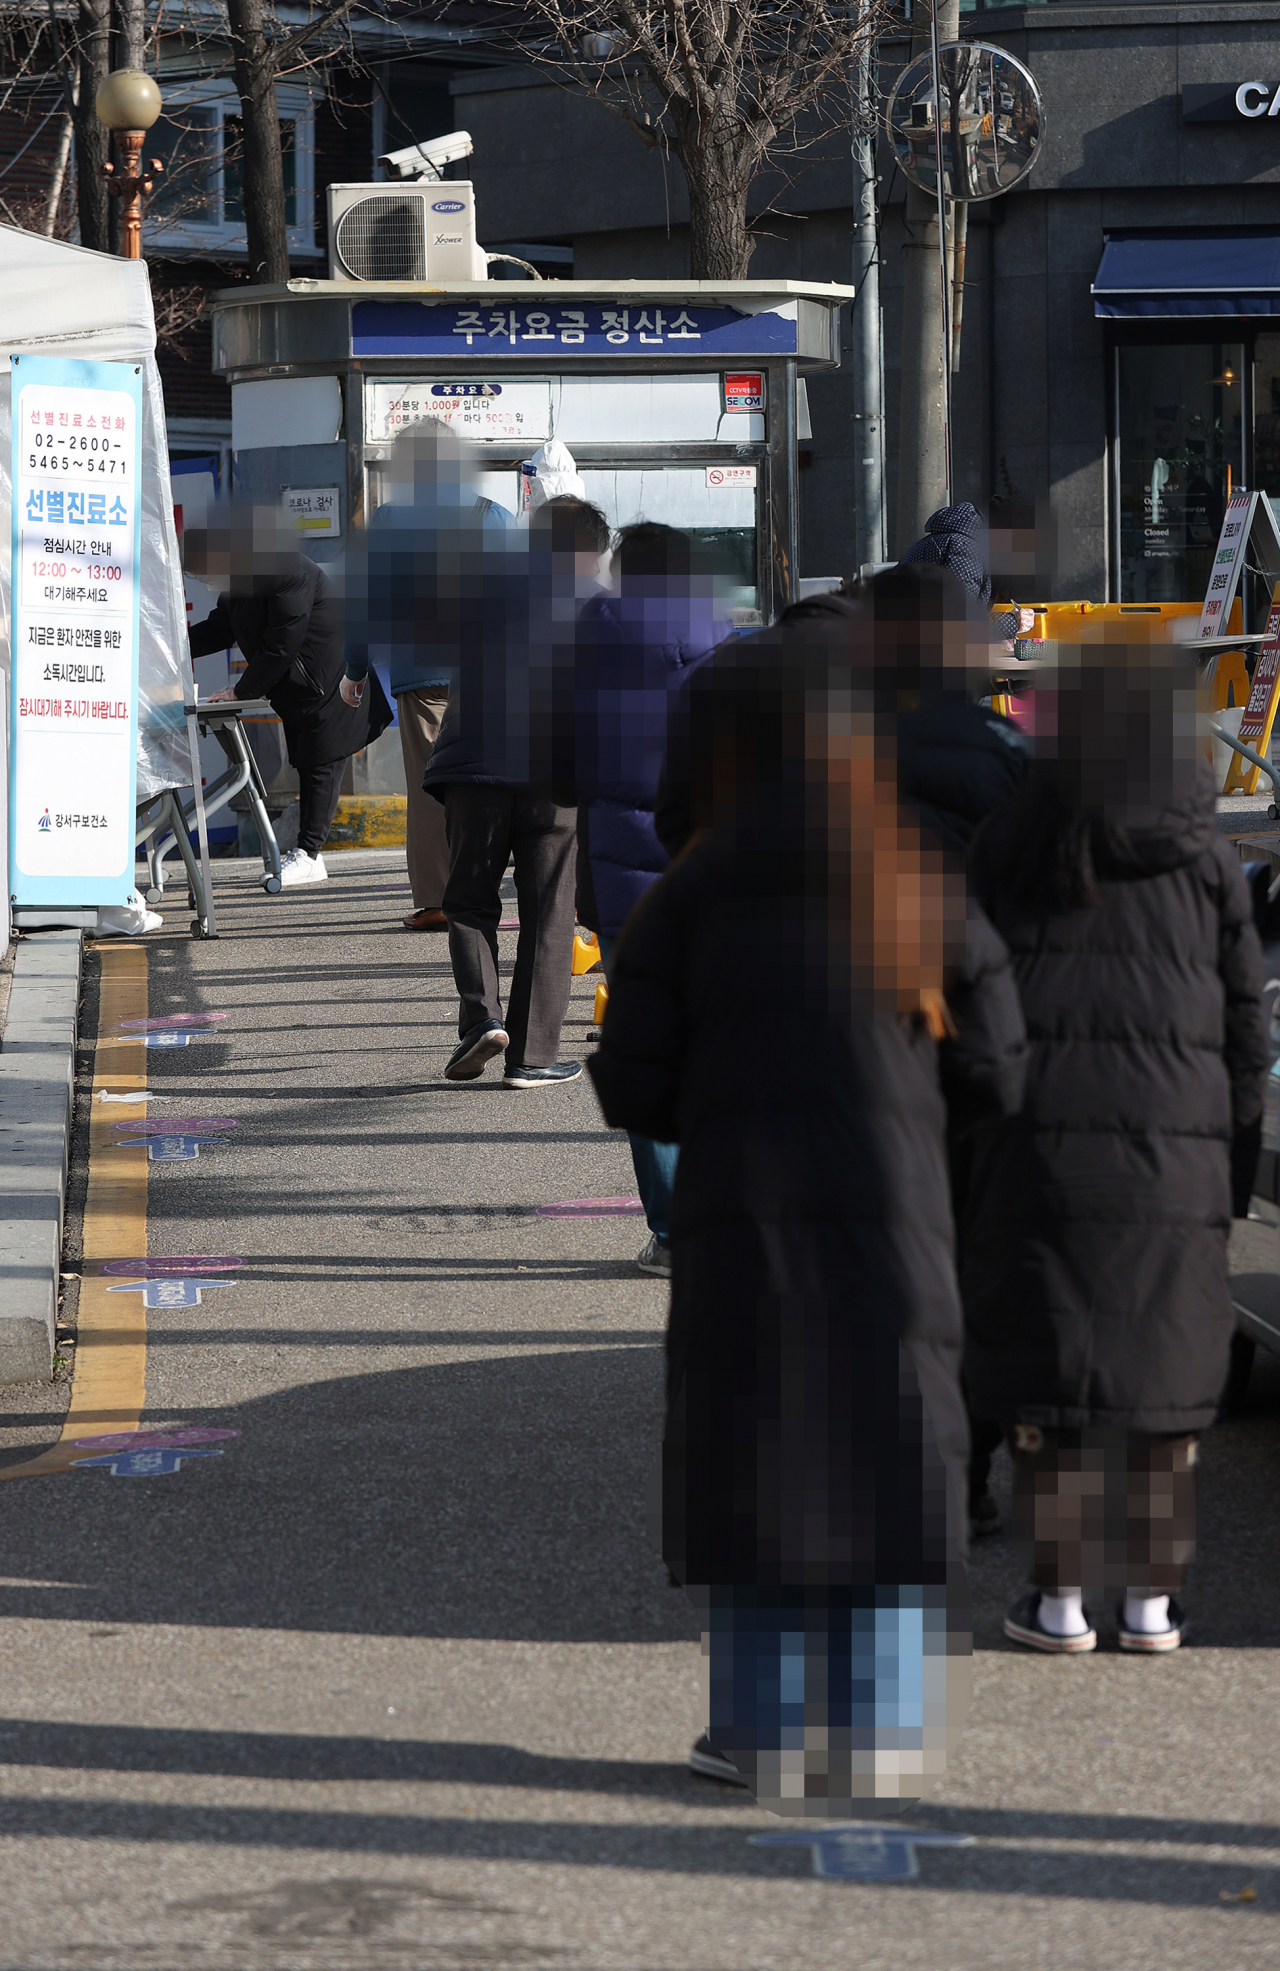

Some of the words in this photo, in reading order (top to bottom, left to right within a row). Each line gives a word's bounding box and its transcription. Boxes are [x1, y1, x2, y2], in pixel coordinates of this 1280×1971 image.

[435, 202, 462, 211] Carrier
[452, 309, 590, 346] 주차요금
[599, 308, 702, 345] 정산소
[389, 400, 420, 411] 30분당
[463, 400, 490, 411] 입니다
[726, 396, 761, 406] SECOM
[30, 409, 126, 432] 선별진료소전화
[464, 413, 482, 424] 마다
[35, 433, 122, 452] 02-2600-
[29, 454, 127, 475] 5465~5471
[26, 489, 128, 526] 선별진료소
[289, 497, 311, 508] 코로나
[316, 495, 333, 507] 검사
[43, 537, 87, 556] 점심시간
[90, 539, 112, 557] 안내
[32, 562, 67, 578] 12:00
[87, 565, 122, 581] 13:00
[44, 586, 108, 603] 대기해주세요
[28, 626, 55, 647] 지금은
[57, 627, 74, 648] 환자
[75, 628, 102, 649] 안전을
[103, 630, 122, 649] 위한
[43, 663, 106, 684] 소독시간입니다.
[1247, 683, 1272, 713] 출입금지
[19, 698, 62, 718] 잠시대기해
[64, 700, 90, 719] 주시기
[91, 701, 129, 720] 바랍니다.
[55, 813, 108, 829] 강서구보건소
